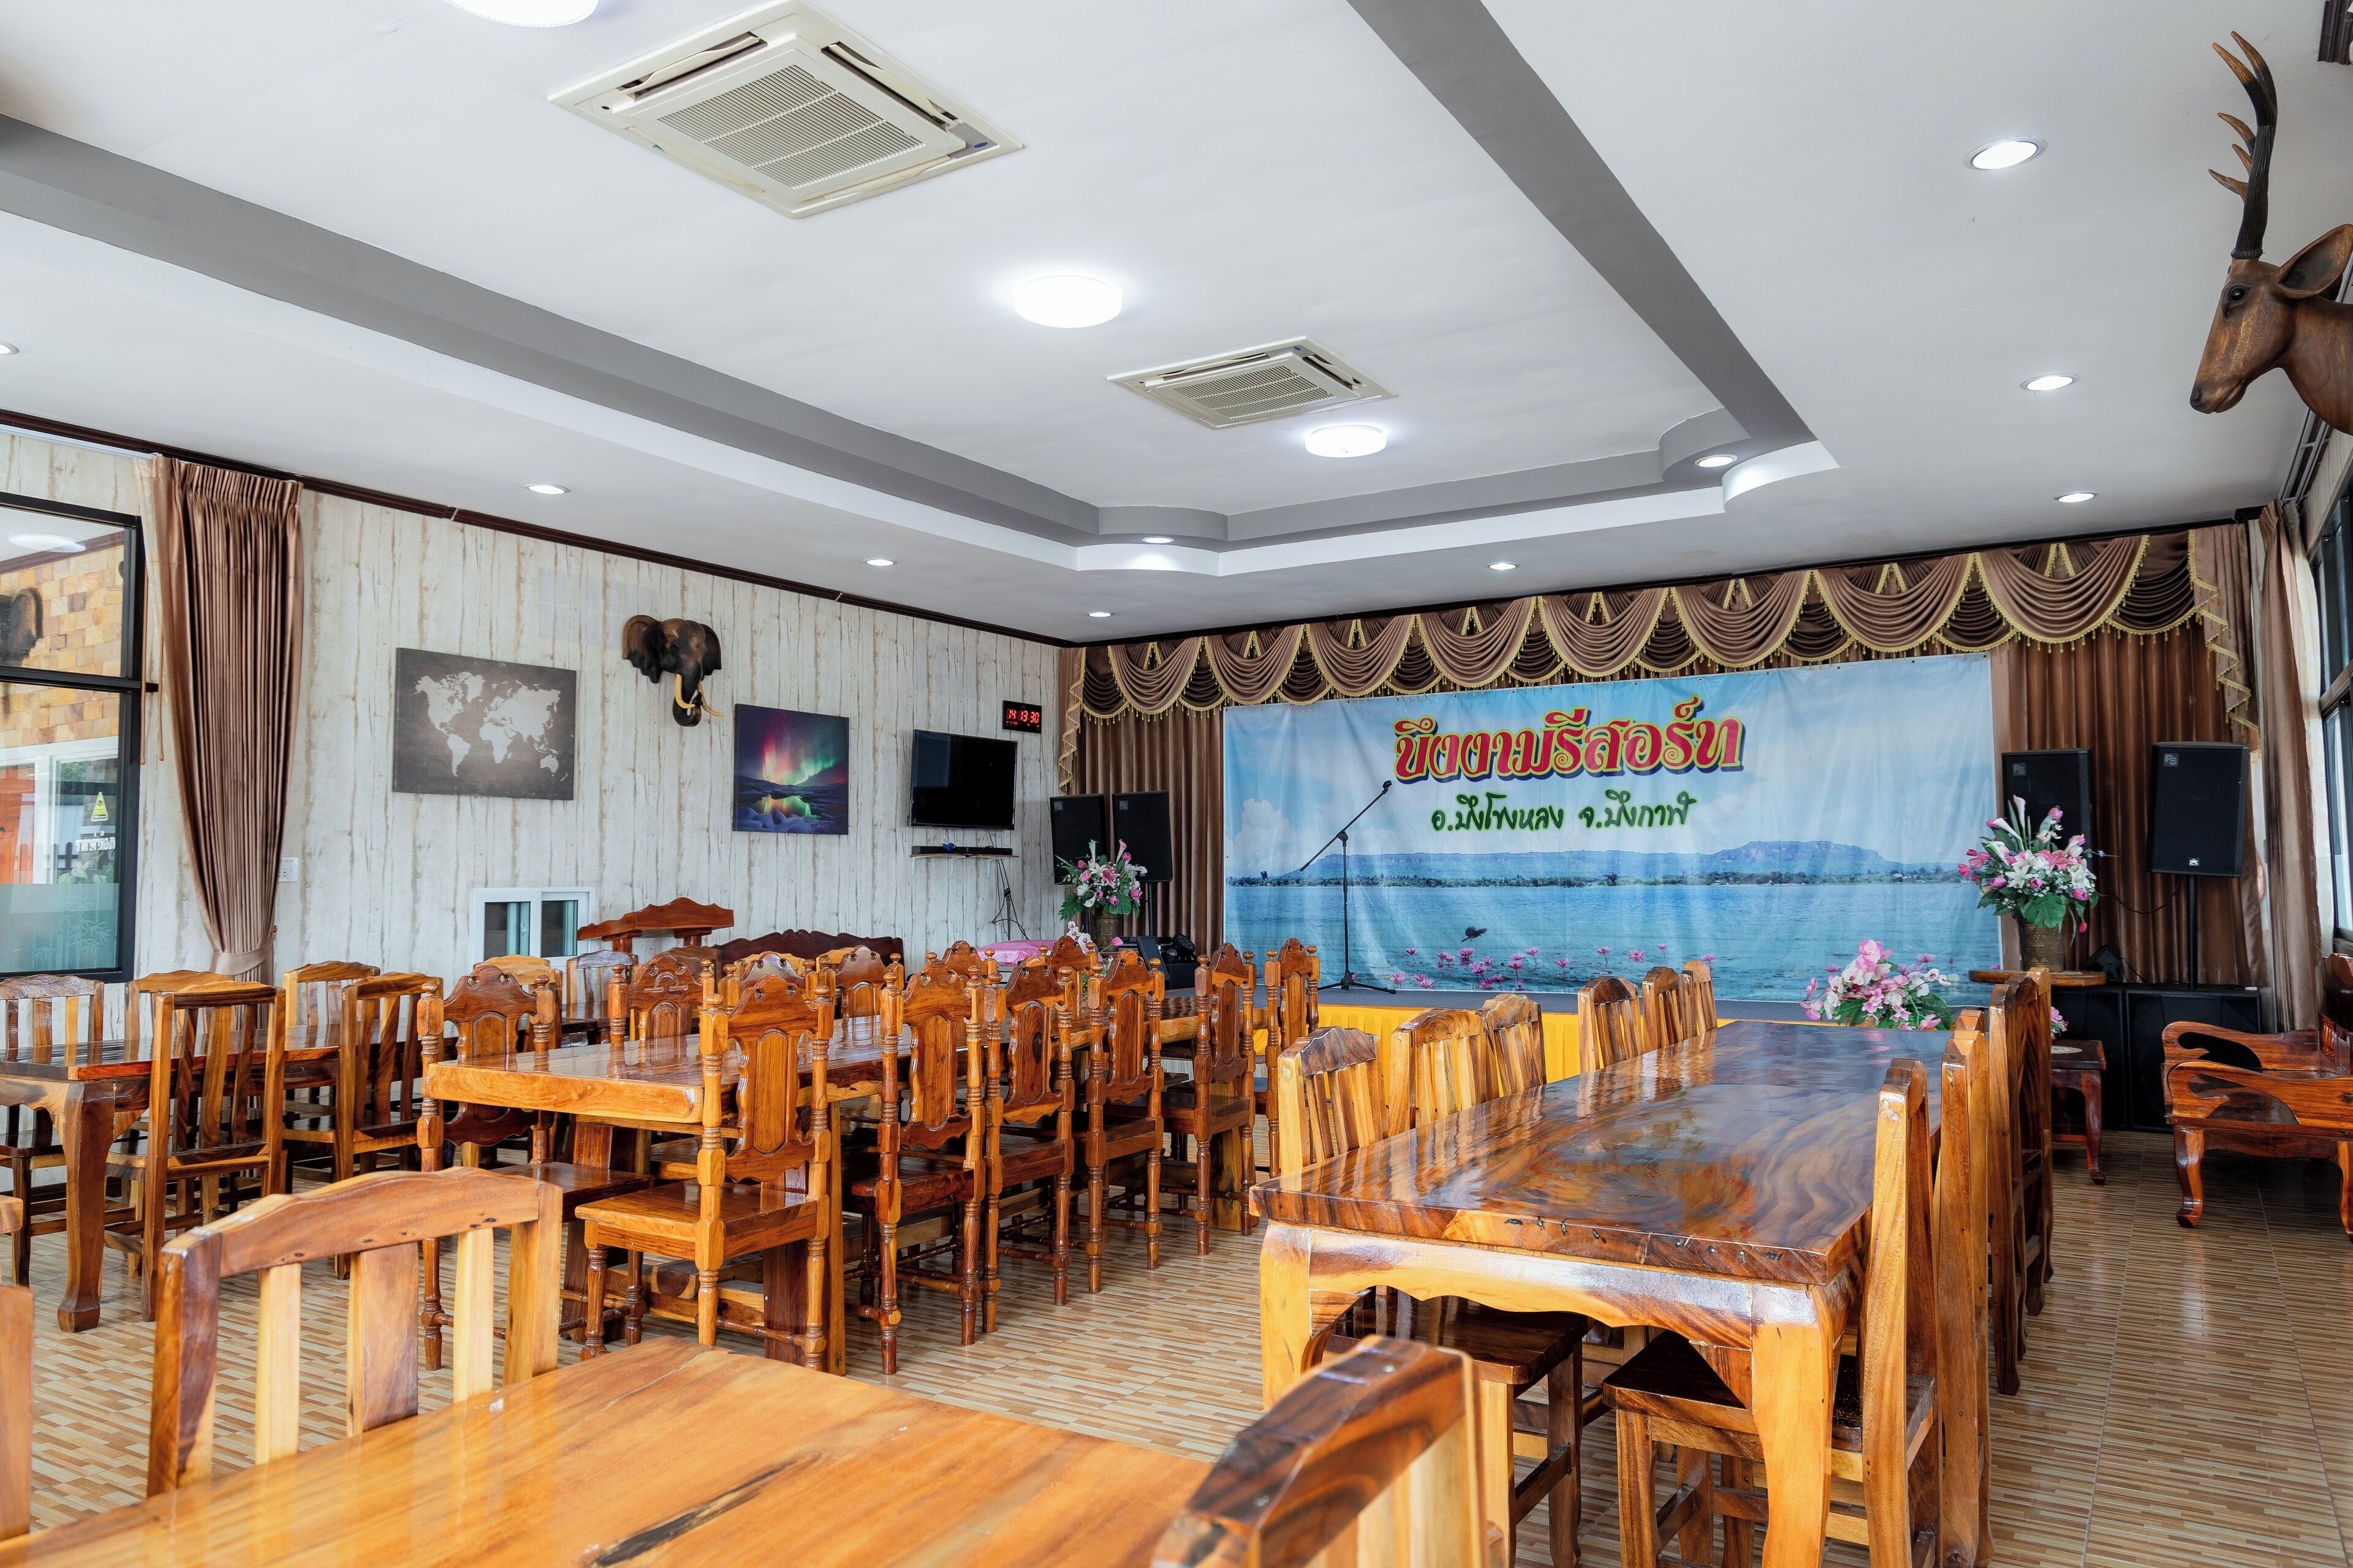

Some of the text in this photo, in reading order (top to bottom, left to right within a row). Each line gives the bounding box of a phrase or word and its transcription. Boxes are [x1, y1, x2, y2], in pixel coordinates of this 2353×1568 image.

[1393, 694, 1745, 783] บึงงามรีสอร์ท
[1431, 789, 1698, 831] อ.บึงโขงหลง จ.บึงกาฬ
